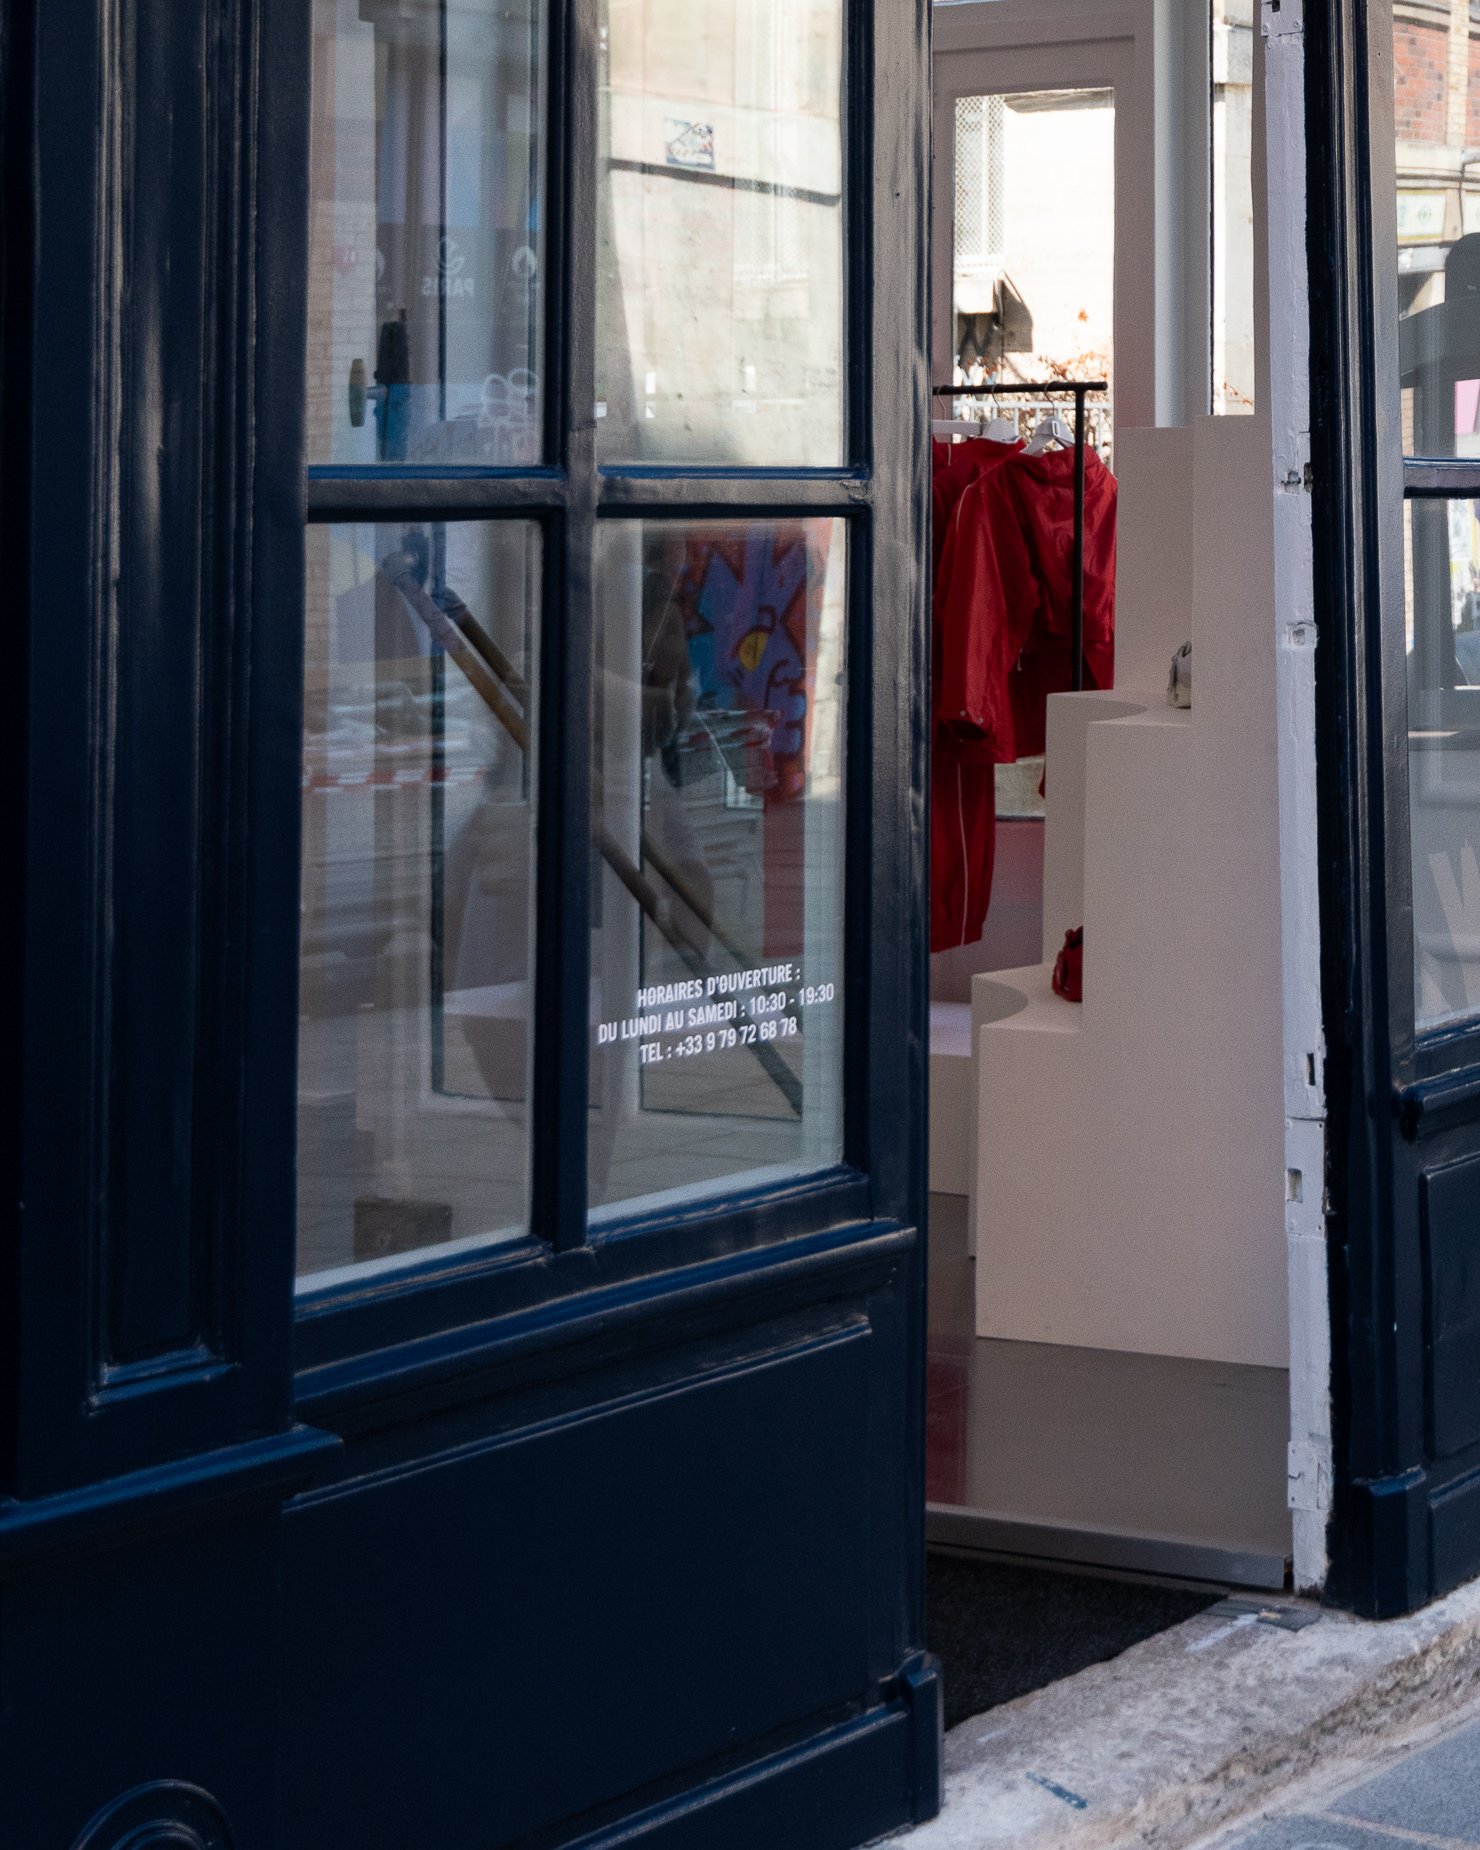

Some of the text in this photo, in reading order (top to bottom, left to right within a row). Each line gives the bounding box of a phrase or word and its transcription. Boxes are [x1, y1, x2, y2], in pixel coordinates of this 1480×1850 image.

[637, 979, 703, 1008] HORAIRES
[706, 963, 794, 997] D'OUVERTURE
[597, 1022, 618, 1045] DU
[621, 1013, 662, 1038] LUNDI
[665, 1009, 685, 1032] AU
[688, 1000, 738, 1026] SAMEDI
[750, 991, 787, 1016] 10:30
[799, 982, 835, 1007] 19:30
[640, 1041, 664, 1064] TEL
[675, 1034, 704, 1058] +33
[706, 1030, 717, 1052] 9
[719, 1027, 737, 1050] 79
[739, 1023, 757, 1046] 72
[759, 1019, 778, 1042] 68
[780, 1015, 798, 1038] 78
